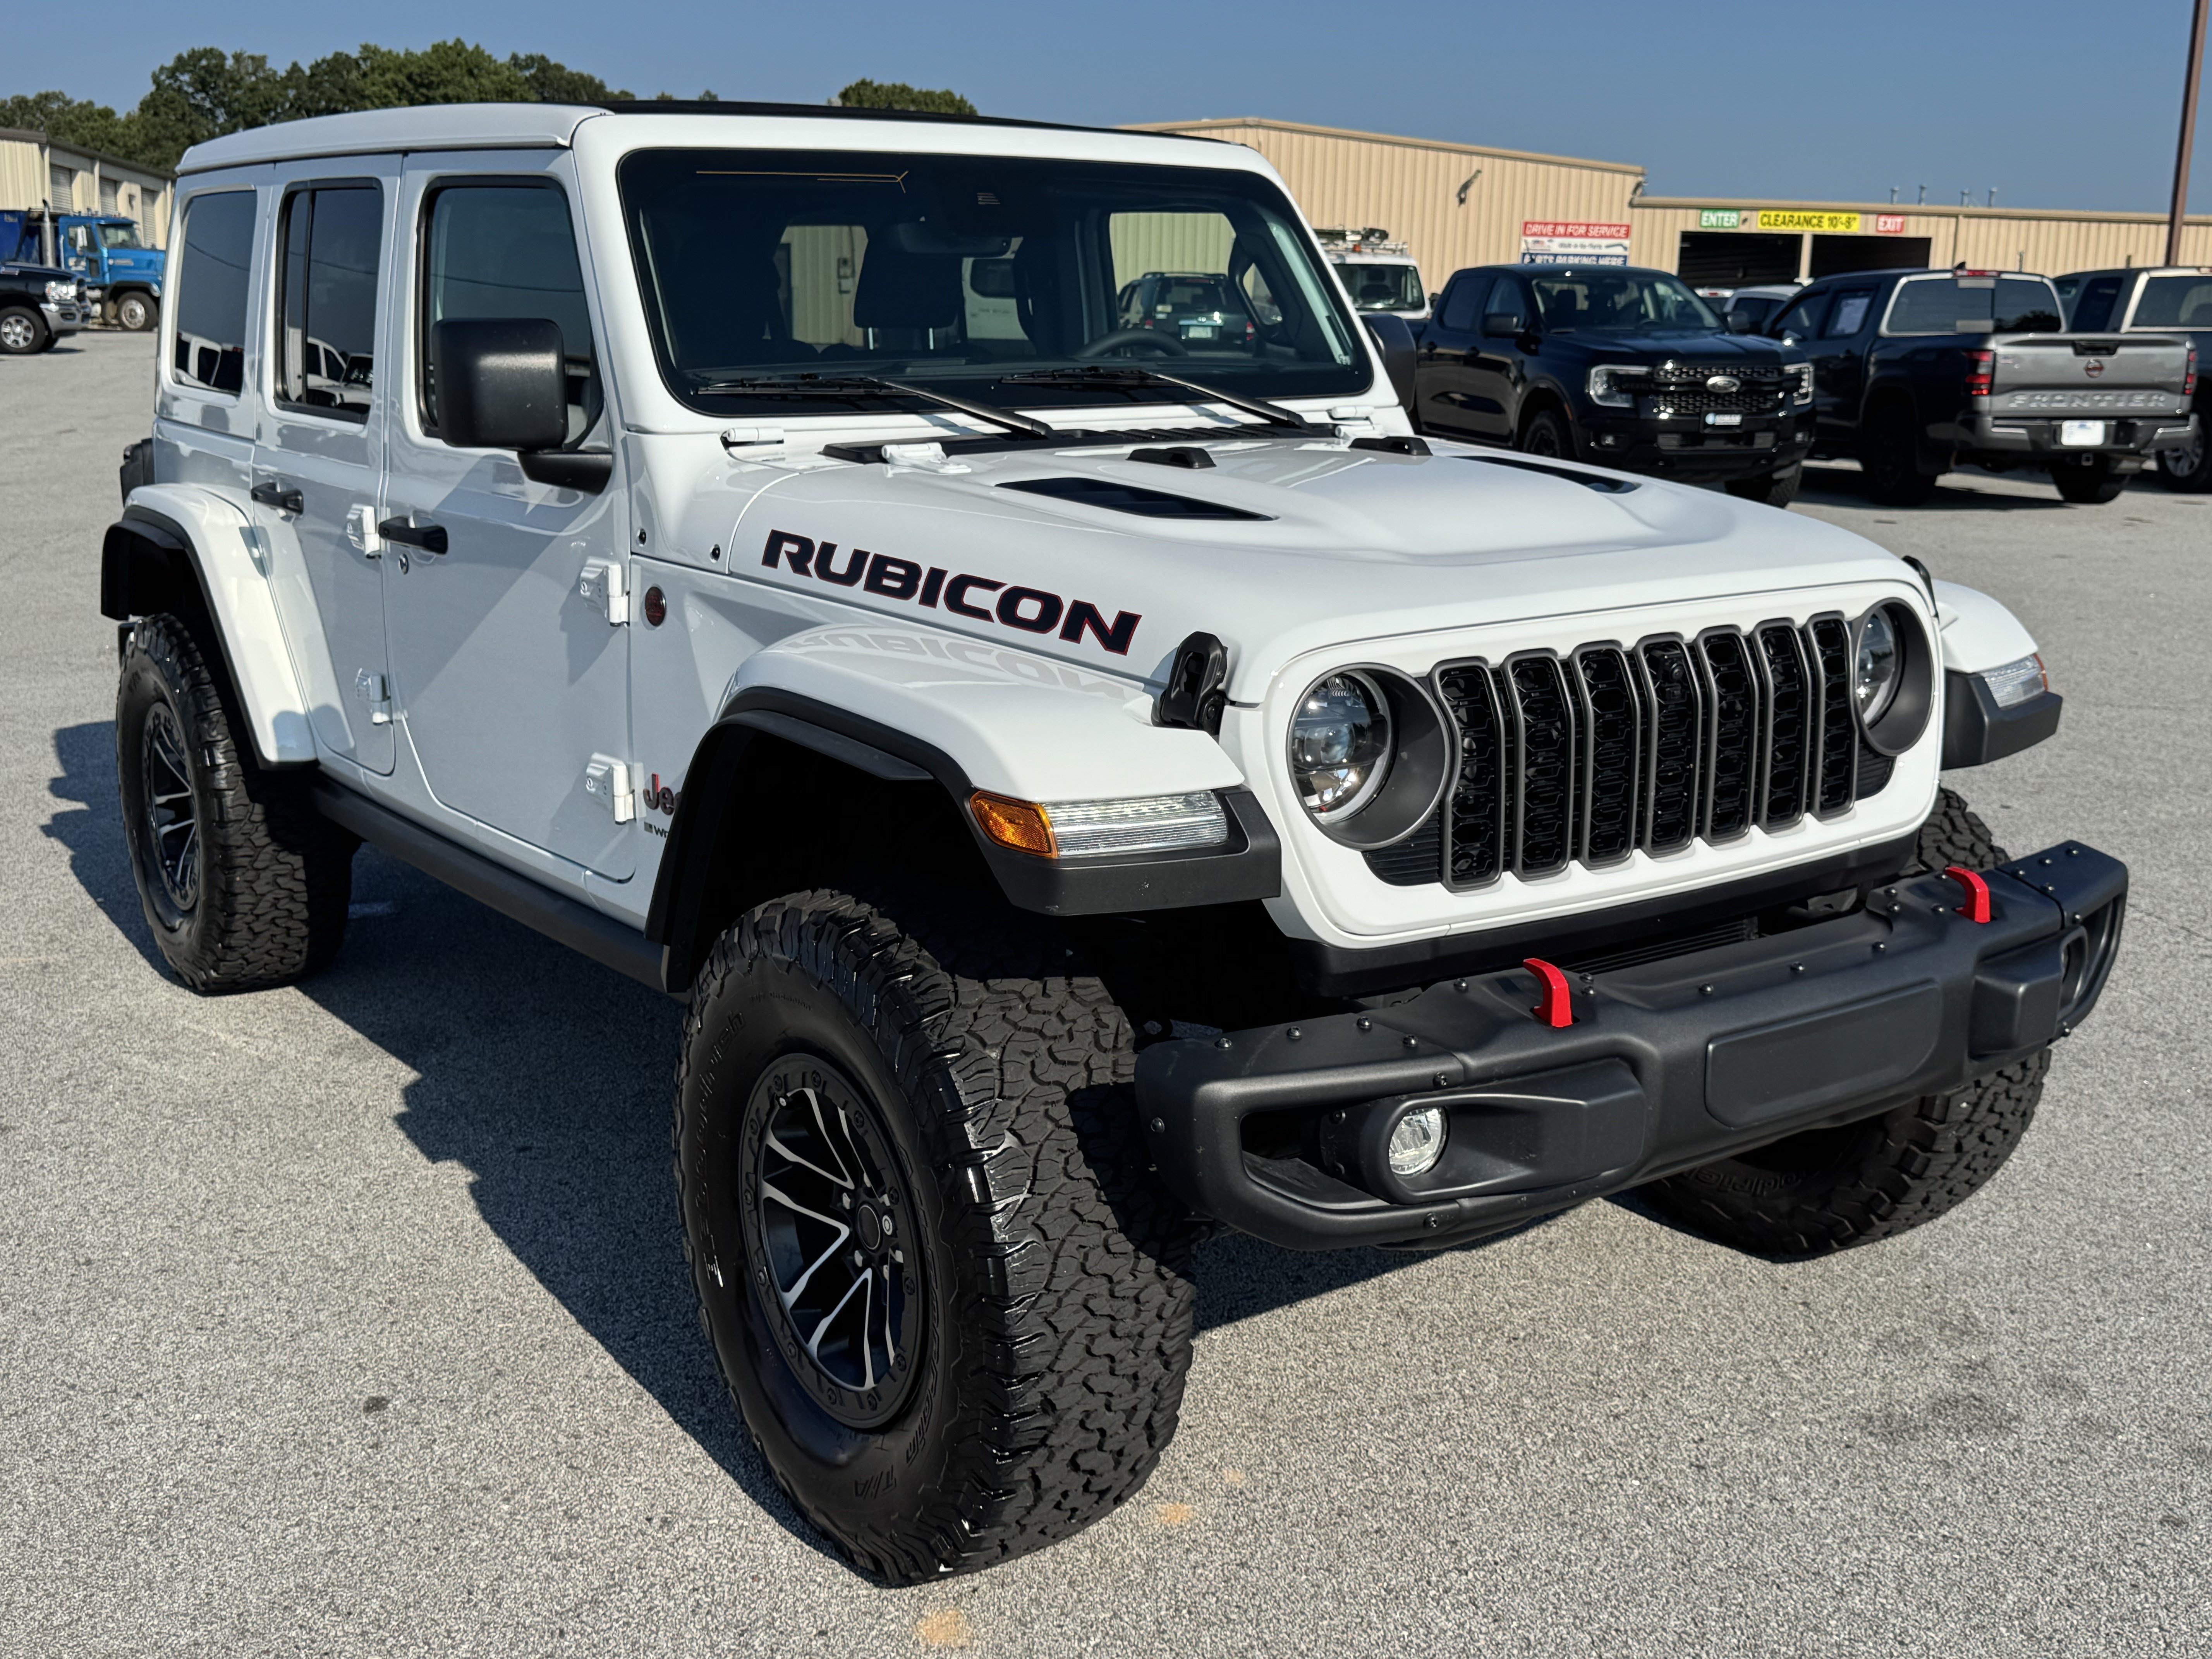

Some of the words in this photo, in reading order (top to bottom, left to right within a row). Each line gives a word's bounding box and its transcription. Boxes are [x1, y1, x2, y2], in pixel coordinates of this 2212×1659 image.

[1701, 212, 1738, 227] ENTER
[1760, 213, 1824, 228] CLEARANCE
[1878, 216, 1904, 231] EXIT
[1525, 223, 1554, 235] DRIVE
[1555, 224, 1566, 235] IN
[1566, 224, 1587, 236] FOR
[1587, 225, 1628, 237] SERVICE
[2008, 393, 2166, 408] FRONTIER
[762, 529, 1142, 656] RUBICON
[643, 773, 682, 815] Je
